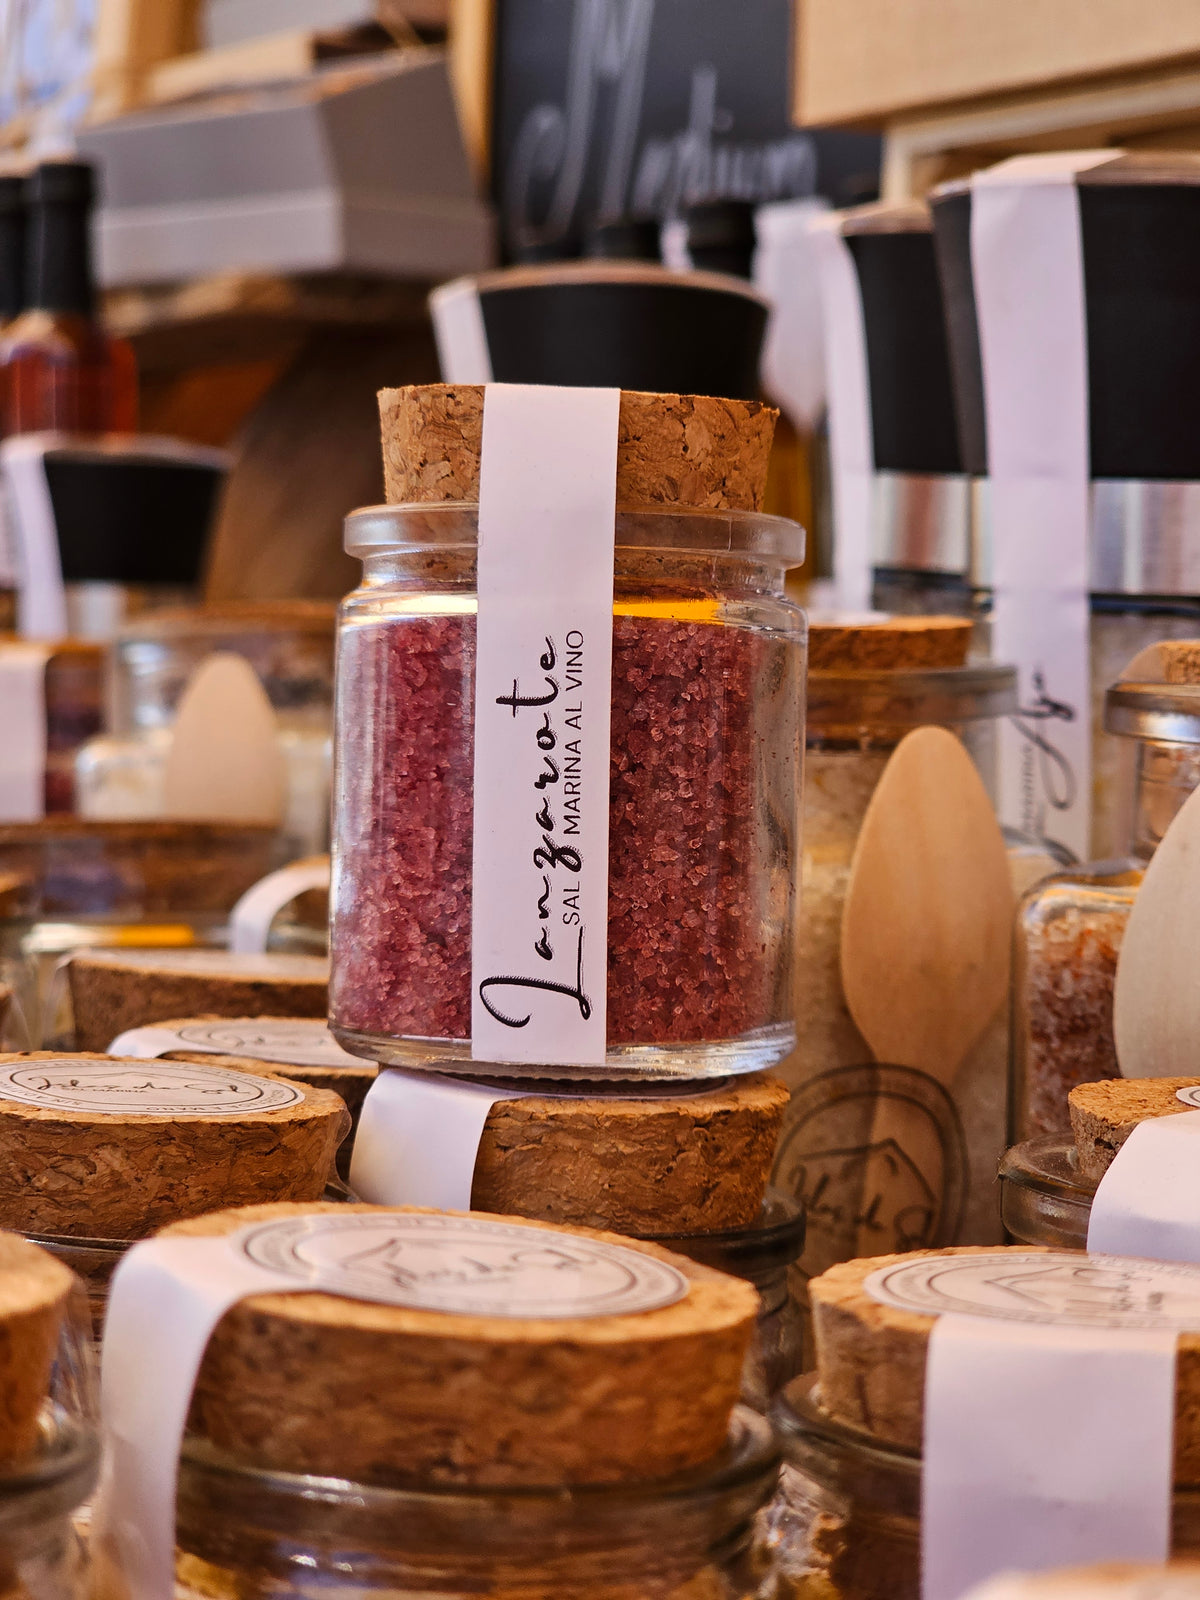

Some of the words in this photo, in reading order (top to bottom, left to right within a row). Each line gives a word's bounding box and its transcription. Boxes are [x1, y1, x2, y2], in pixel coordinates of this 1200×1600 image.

[565, 630, 584, 692] VINO
[564, 700, 583, 731] AL
[563, 739, 582, 836] MARINA
[479, 635, 592, 1029] Lanzarote
[563, 881, 581, 926] SAL
